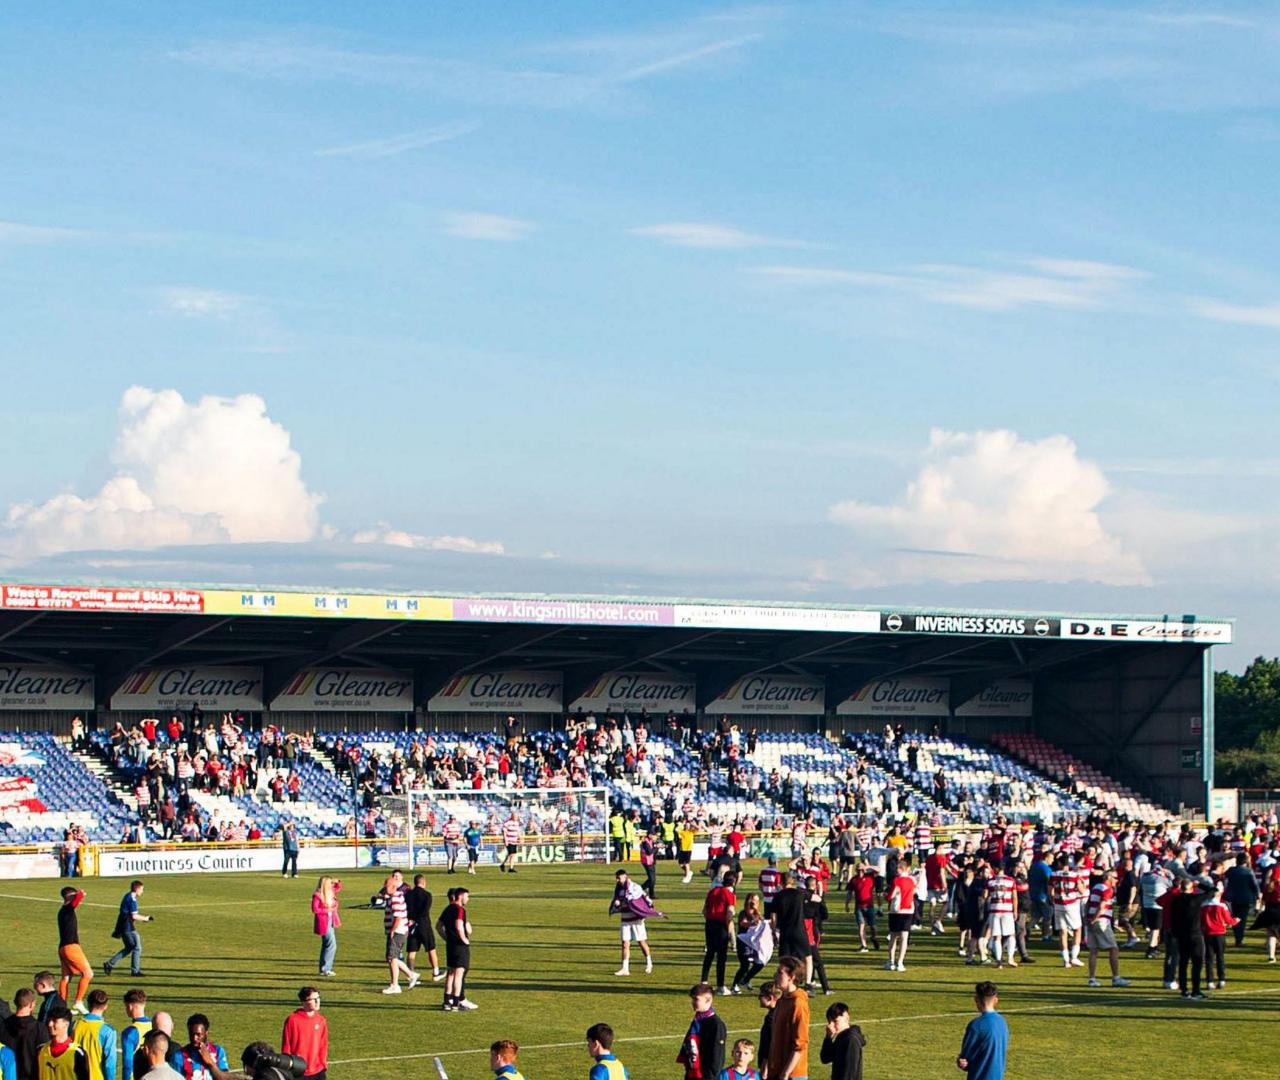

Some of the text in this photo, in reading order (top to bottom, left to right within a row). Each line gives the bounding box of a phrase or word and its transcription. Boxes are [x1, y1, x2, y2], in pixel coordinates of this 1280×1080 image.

[7, 588, 200, 604] Waste Recycling and Skip Hire
[469, 602, 658, 622] www.kingsmillshotel.com
[916, 617, 1025, 635] INVERNESS SOFAS
[158, 668, 261, 696] Gleaner
[315, 671, 413, 697] Gleaner
[470, 673, 562, 699] Gleaner
[608, 674, 694, 700] Gleaner
[742, 676, 825, 702] Gleaner
[872, 679, 949, 704] Gleaner
[114, 855, 254, 873] Inverness Courier
